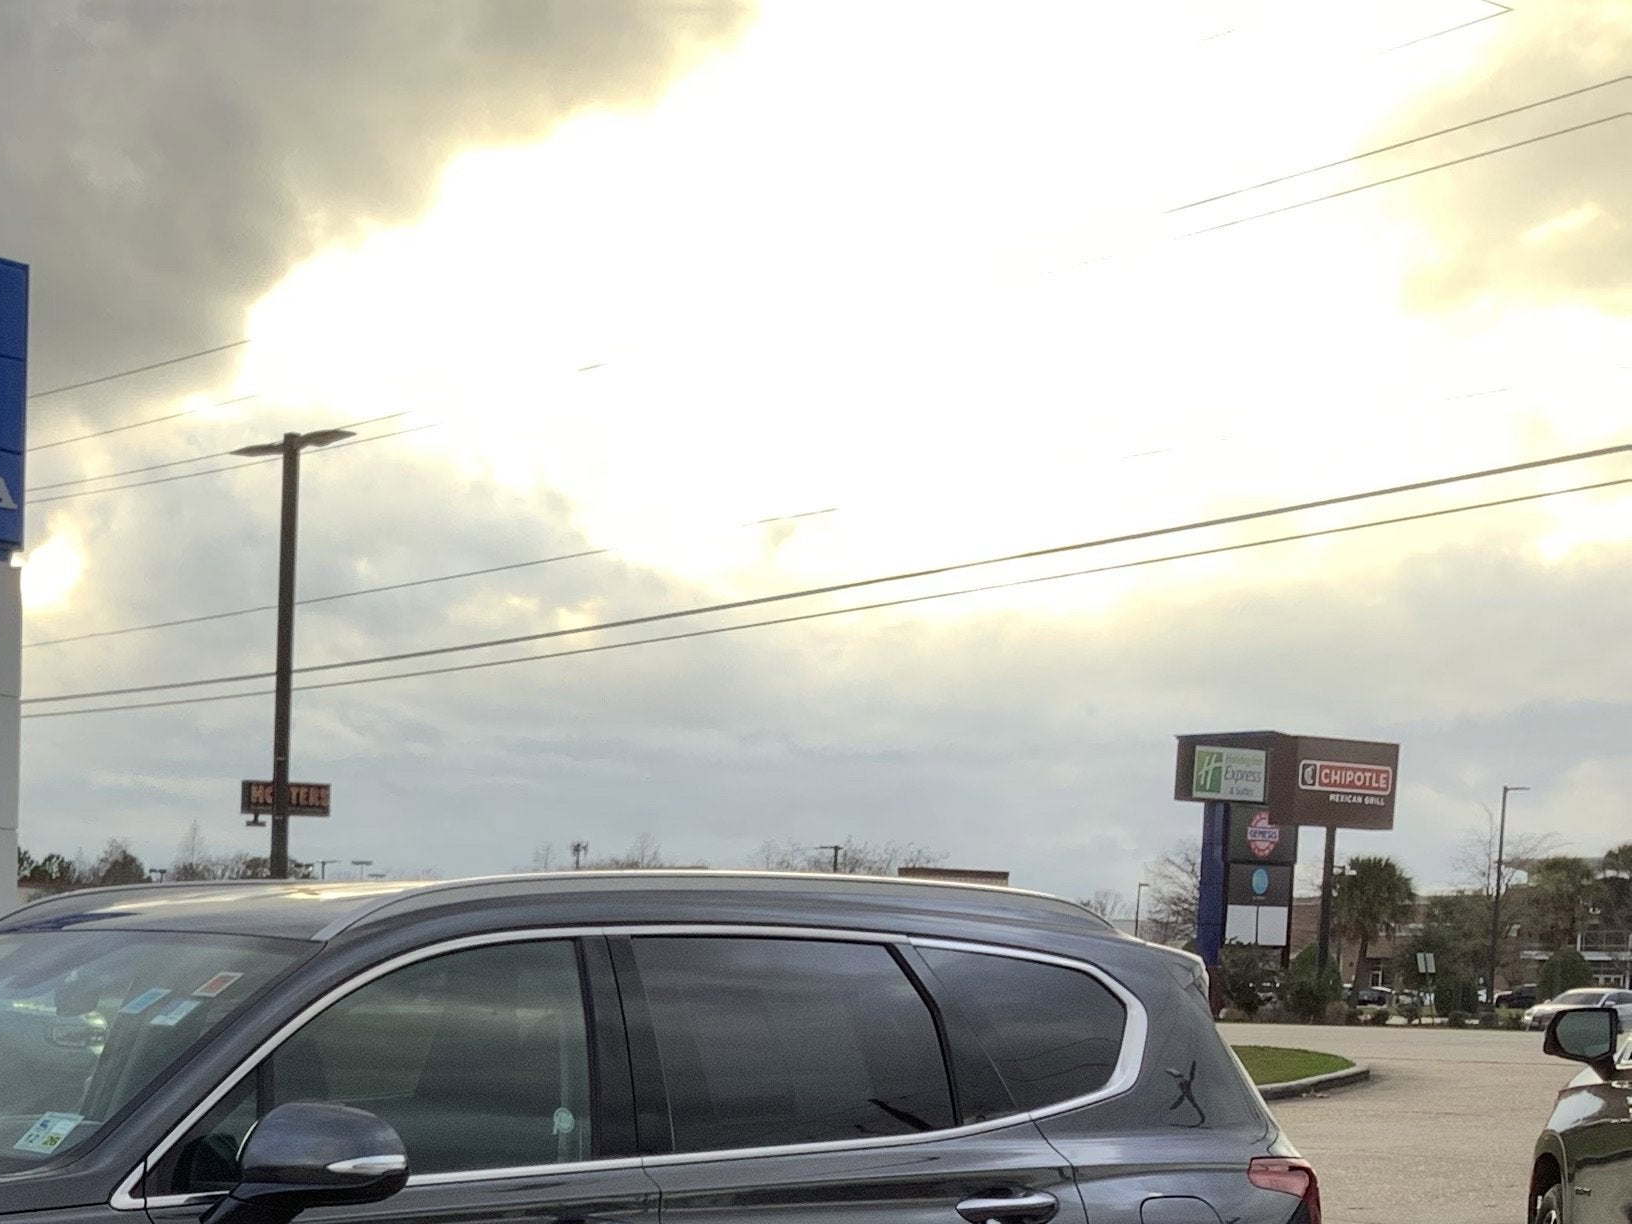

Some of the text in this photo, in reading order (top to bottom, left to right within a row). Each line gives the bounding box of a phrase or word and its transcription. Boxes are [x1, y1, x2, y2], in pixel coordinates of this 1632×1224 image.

[1224, 766, 1262, 784] Express
[1321, 768, 1388, 788] CHIPOTLE
[250, 784, 330, 806] HOTERS
[1329, 793, 1385, 806] MEXICAN GRILL
[42, 1135, 60, 1146] 26
